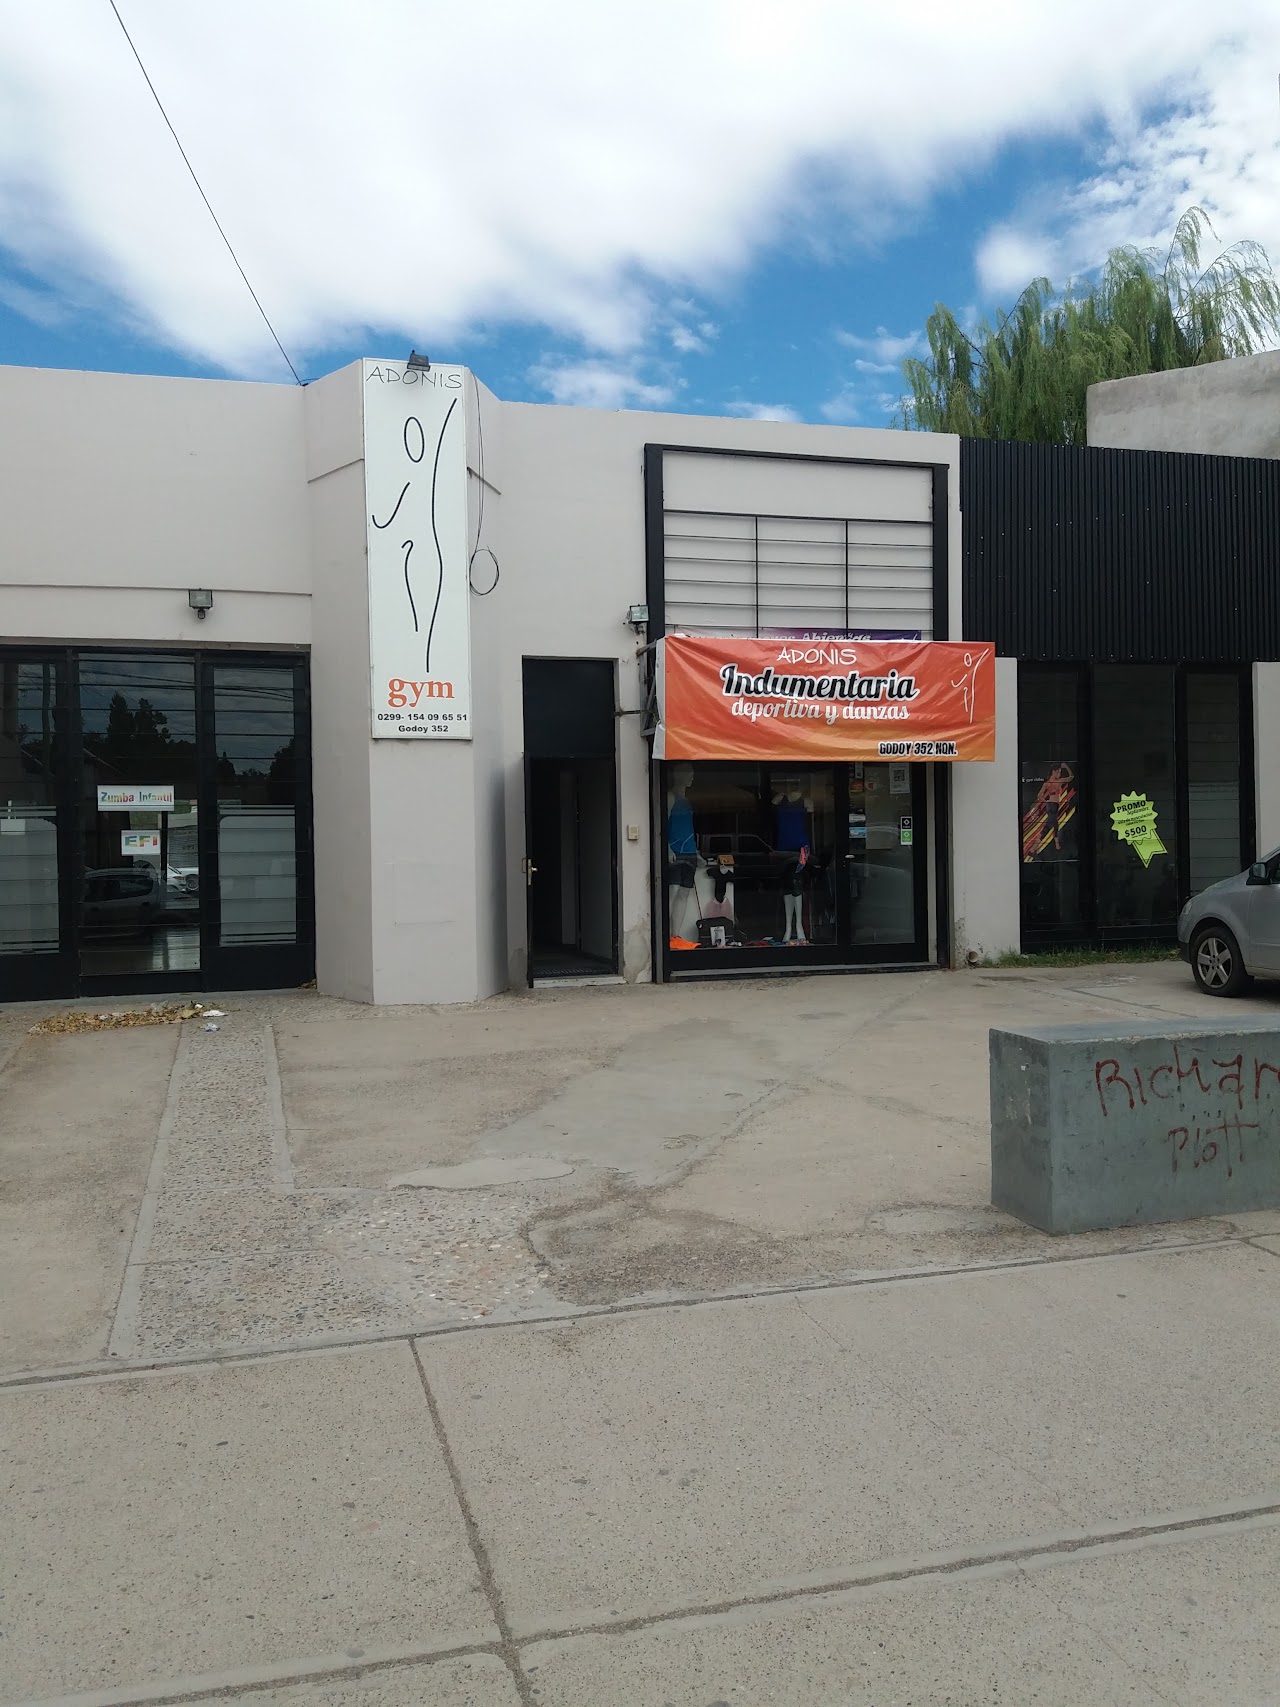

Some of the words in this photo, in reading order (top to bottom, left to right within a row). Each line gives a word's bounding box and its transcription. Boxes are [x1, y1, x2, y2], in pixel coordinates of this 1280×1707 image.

[366, 366, 462, 388] ADONIS
[776, 647, 857, 665] ADONIS
[720, 664, 919, 700] Indumentaria
[388, 678, 454, 708] gym
[377, 713, 404, 721] 0299-
[407, 713, 425, 721] 154
[427, 713, 439, 721] 09
[442, 713, 454, 721] 65
[456, 713, 467, 721] 51
[731, 698, 822, 722] deportiva
[825, 704, 839, 725] y
[842, 702, 910, 720] danzas
[398, 725, 428, 733] Godoy
[431, 725, 449, 733] 352
[879, 742, 912, 755] GODOY
[914, 742, 933, 755] 352
[101, 791, 135, 803] Zumba
[139, 791, 172, 803] Infantil
[1116, 800, 1146, 813] PROMO
[1124, 825, 1147, 837] $500
[125, 835, 158, 848] EFI
